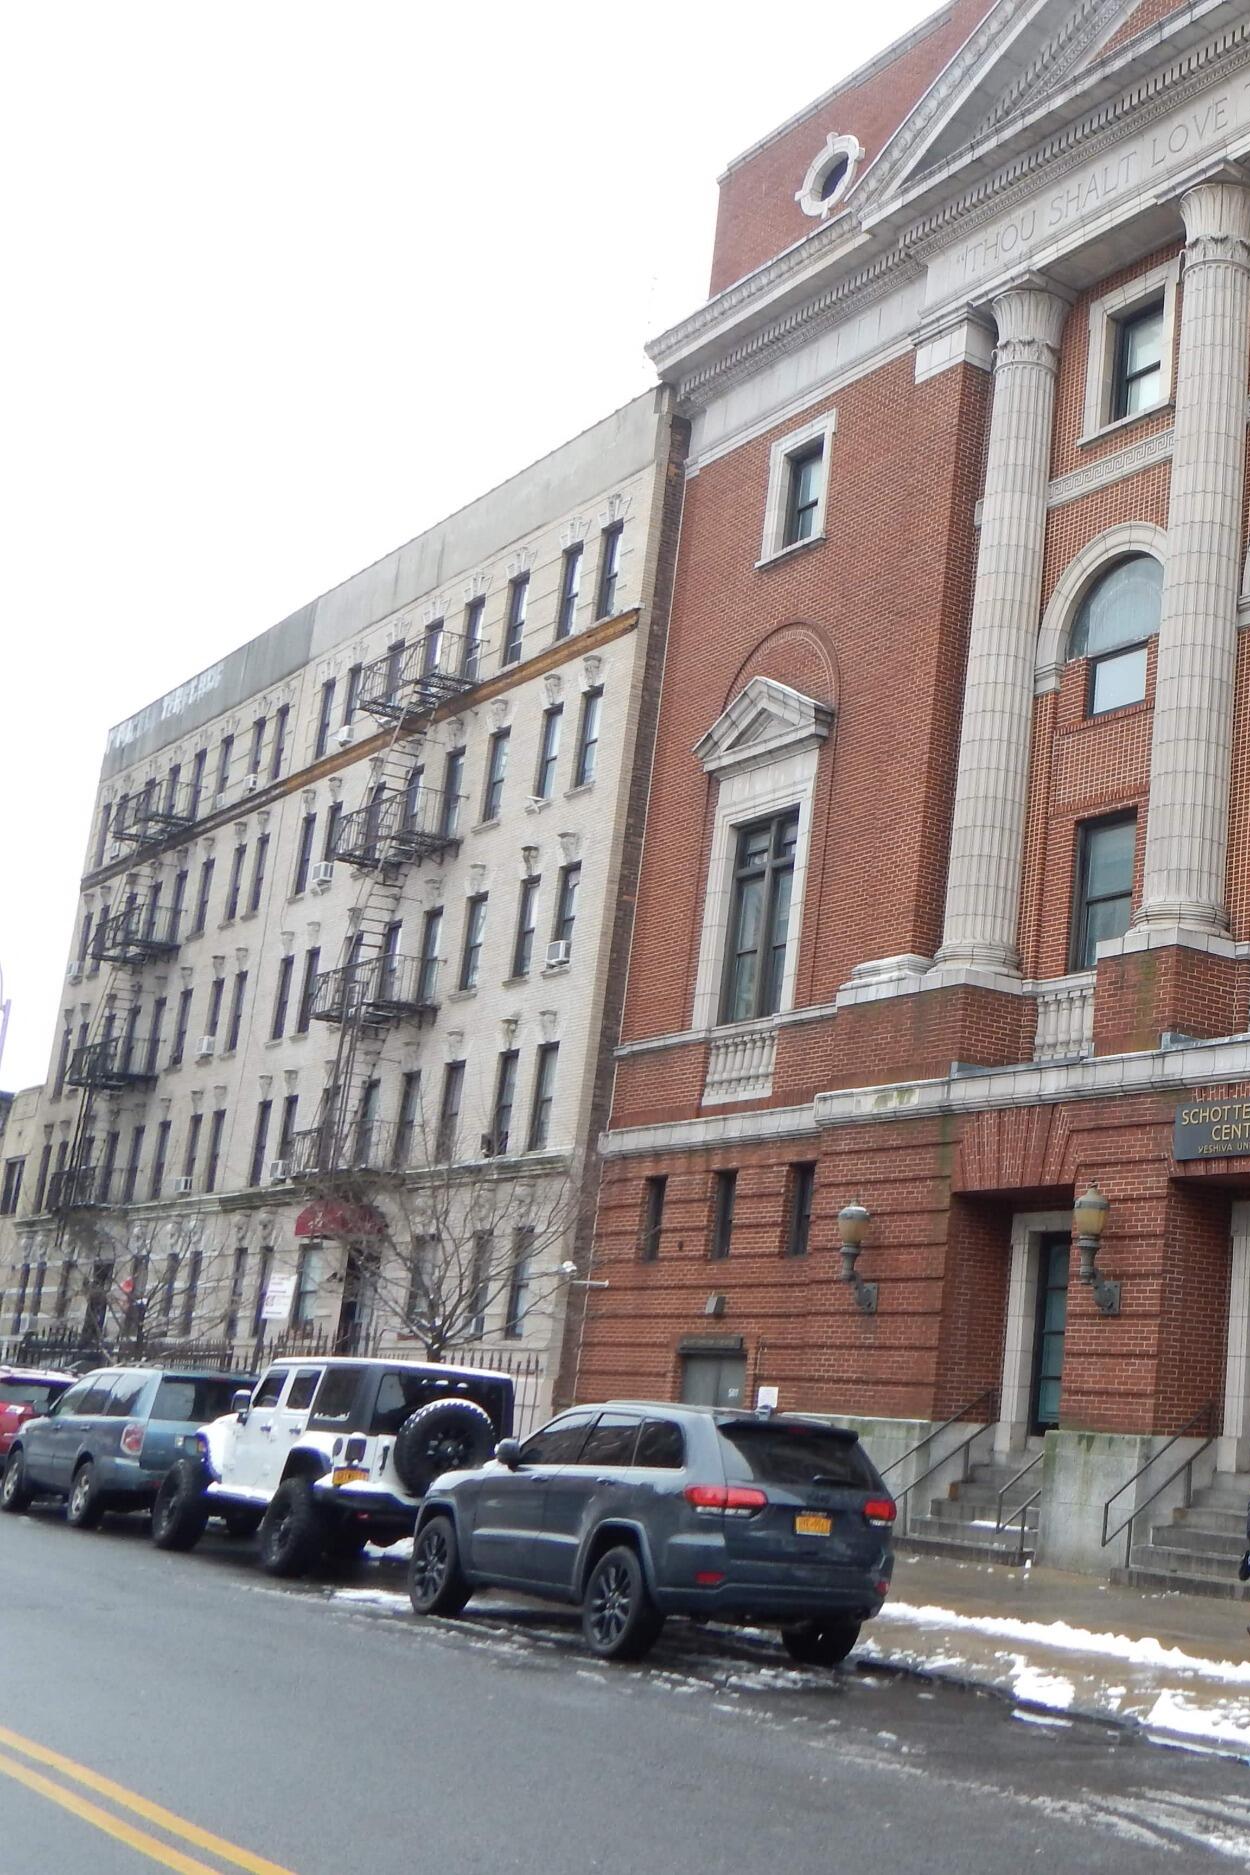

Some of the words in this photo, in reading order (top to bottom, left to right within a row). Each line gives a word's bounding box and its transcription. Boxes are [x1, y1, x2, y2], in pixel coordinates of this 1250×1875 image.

[1049, 151, 1137, 226] SHALT
[1151, 97, 1229, 168] LOVE
[1198, 1143, 1233, 1154] YESHIVA
